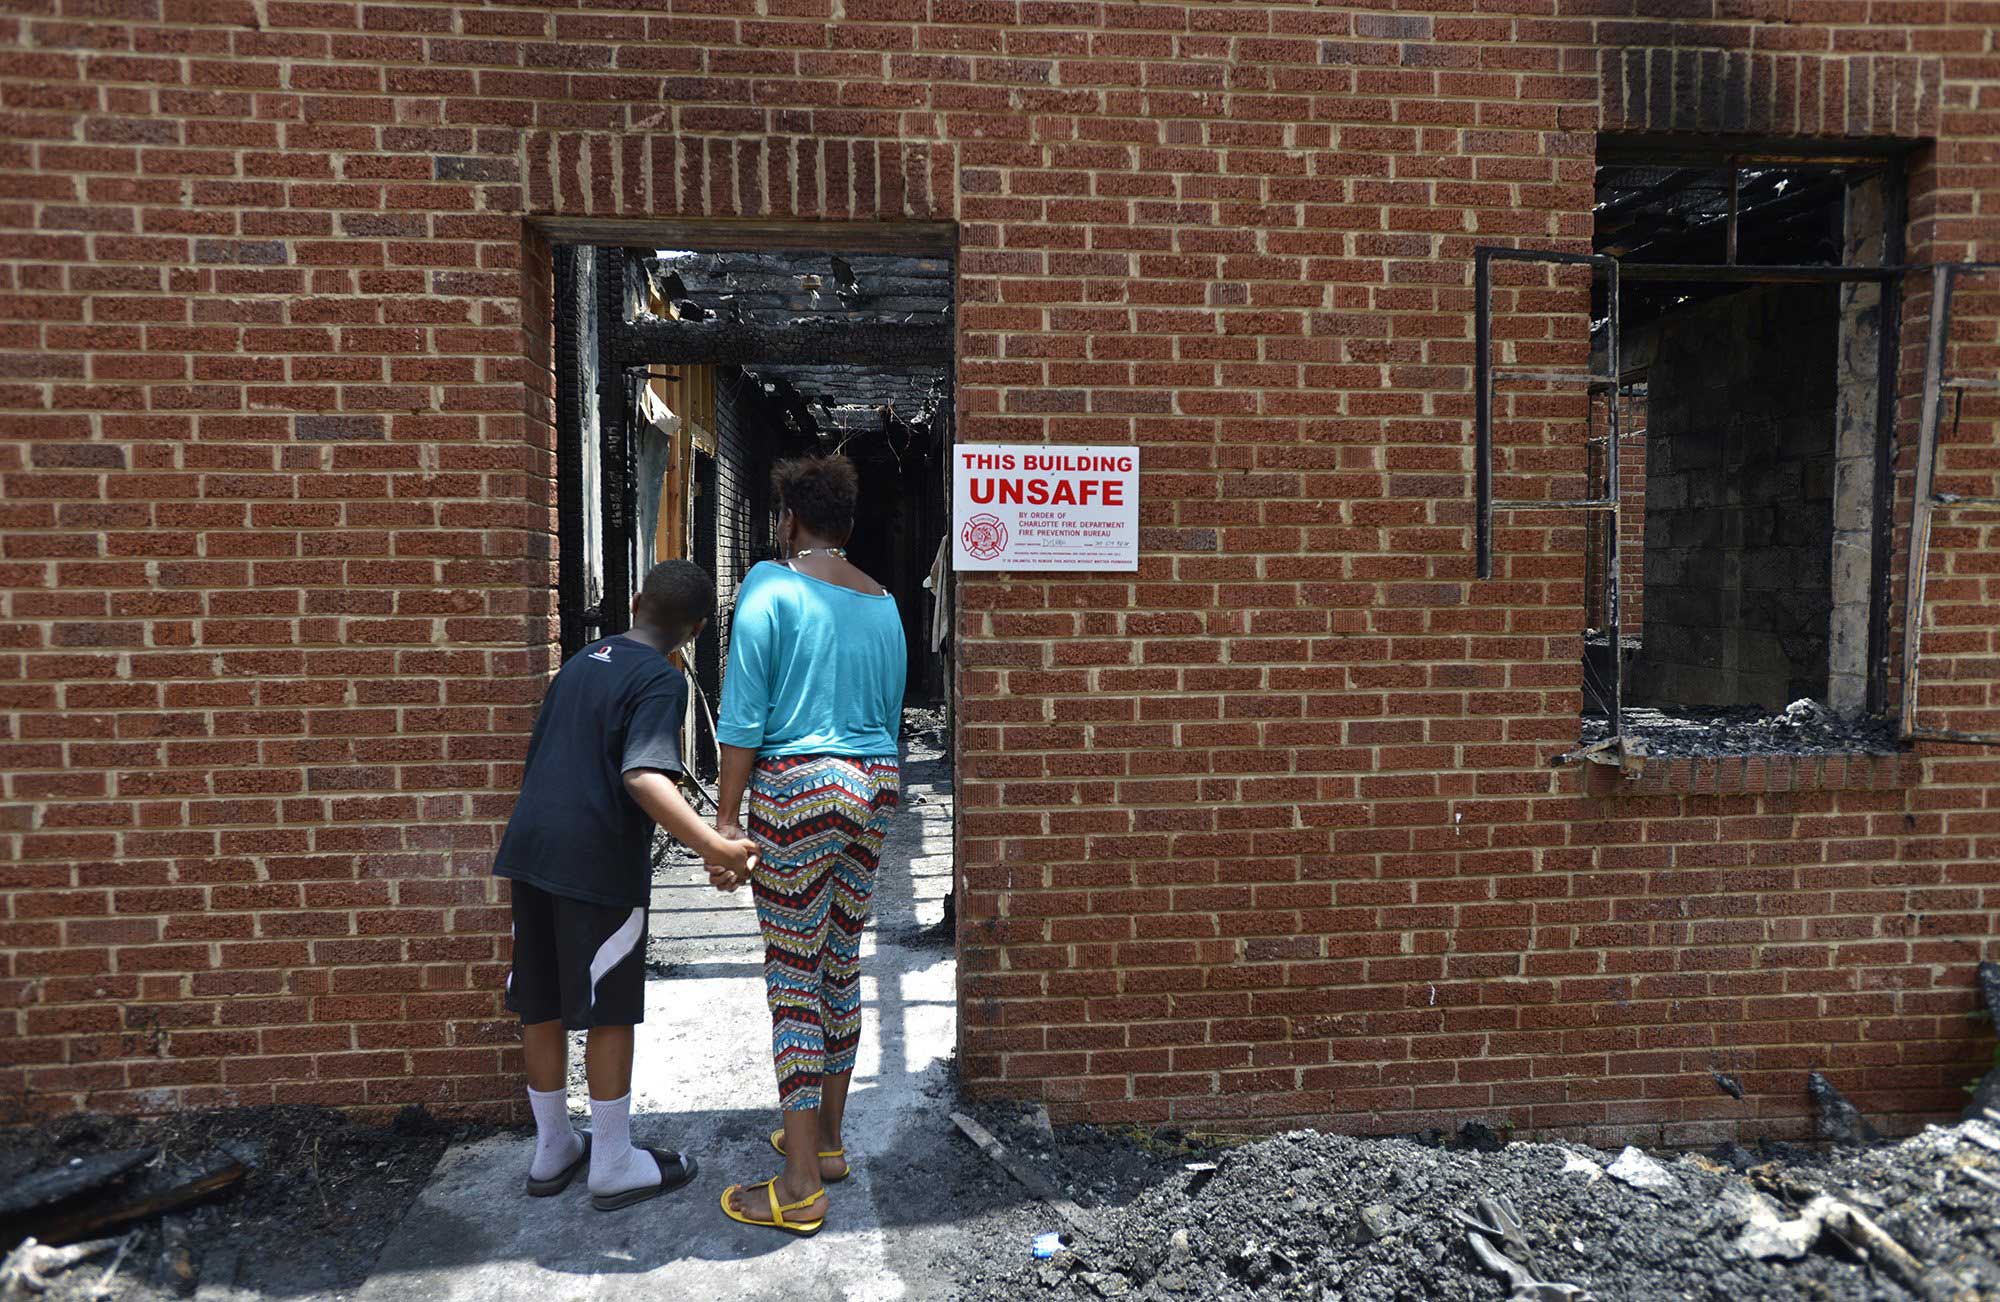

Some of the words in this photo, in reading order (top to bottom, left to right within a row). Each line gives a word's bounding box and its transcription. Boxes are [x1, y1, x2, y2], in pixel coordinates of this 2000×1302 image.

[962, 454, 1016, 470] THIS
[1023, 455, 1133, 472] BUILDING
[969, 478, 1124, 506] UNSAFE
[1018, 520, 1059, 528] CHARLOTTE
[1079, 521, 1125, 529] DEPARTMENT
[1036, 529, 1081, 537] PREVENTION
